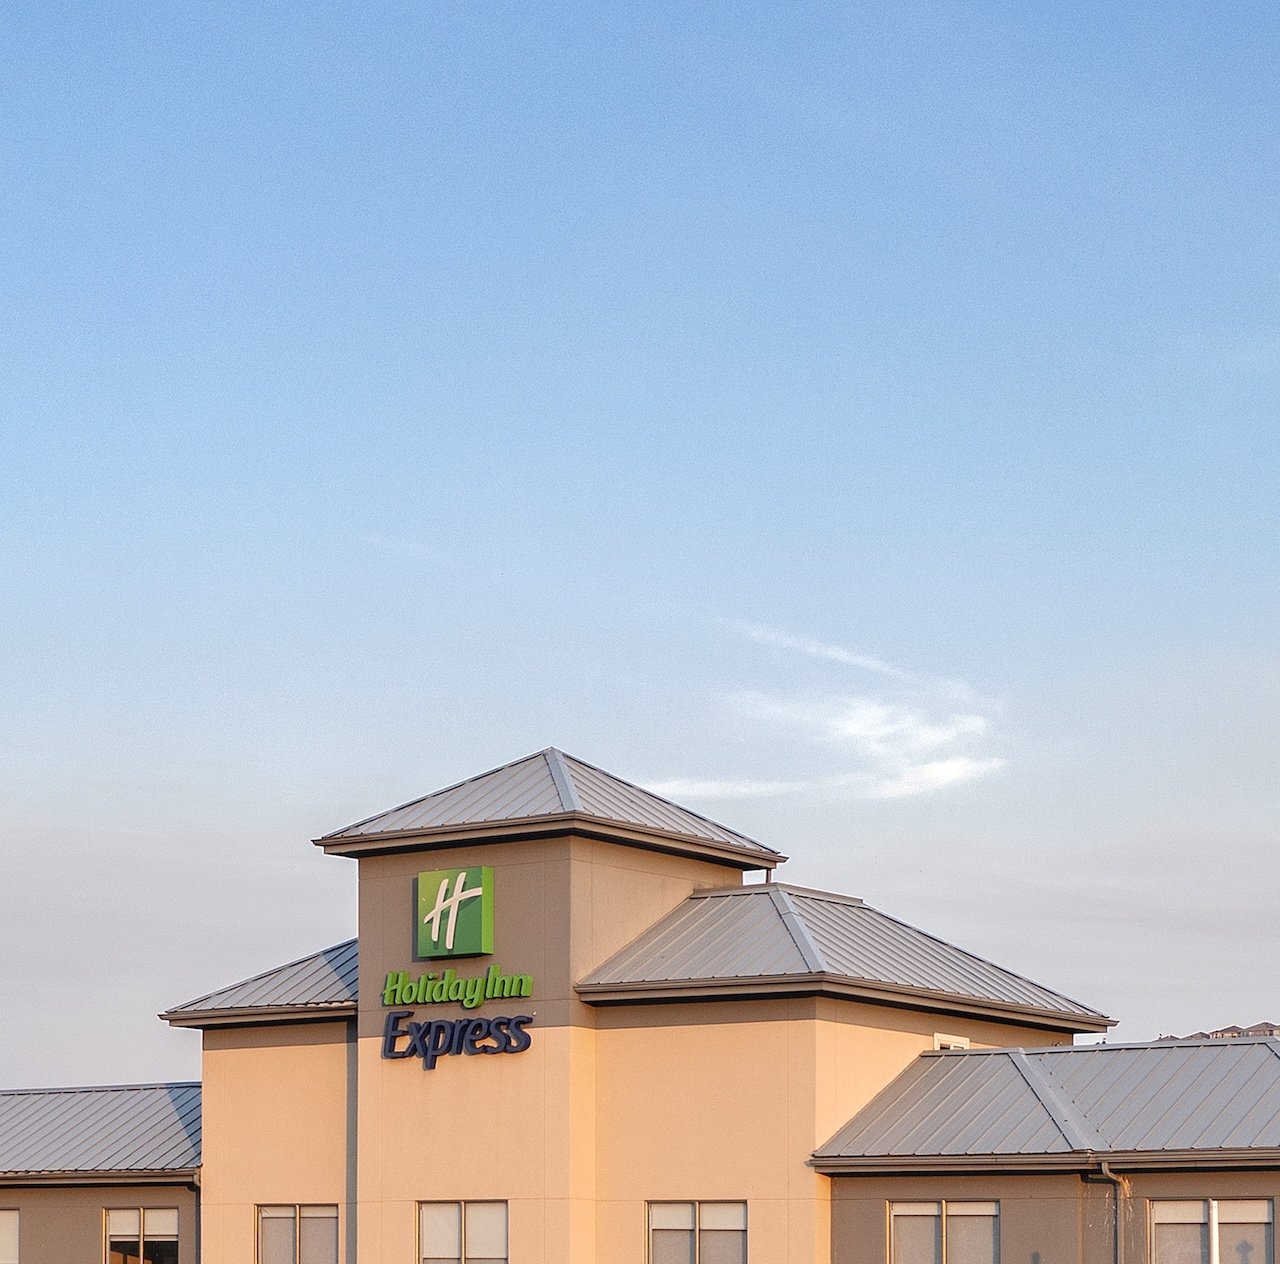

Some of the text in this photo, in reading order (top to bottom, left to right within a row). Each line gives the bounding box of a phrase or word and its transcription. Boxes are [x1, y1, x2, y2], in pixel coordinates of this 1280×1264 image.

[382, 963, 534, 1009] Holiday Inn
[382, 1011, 534, 1070] Express
